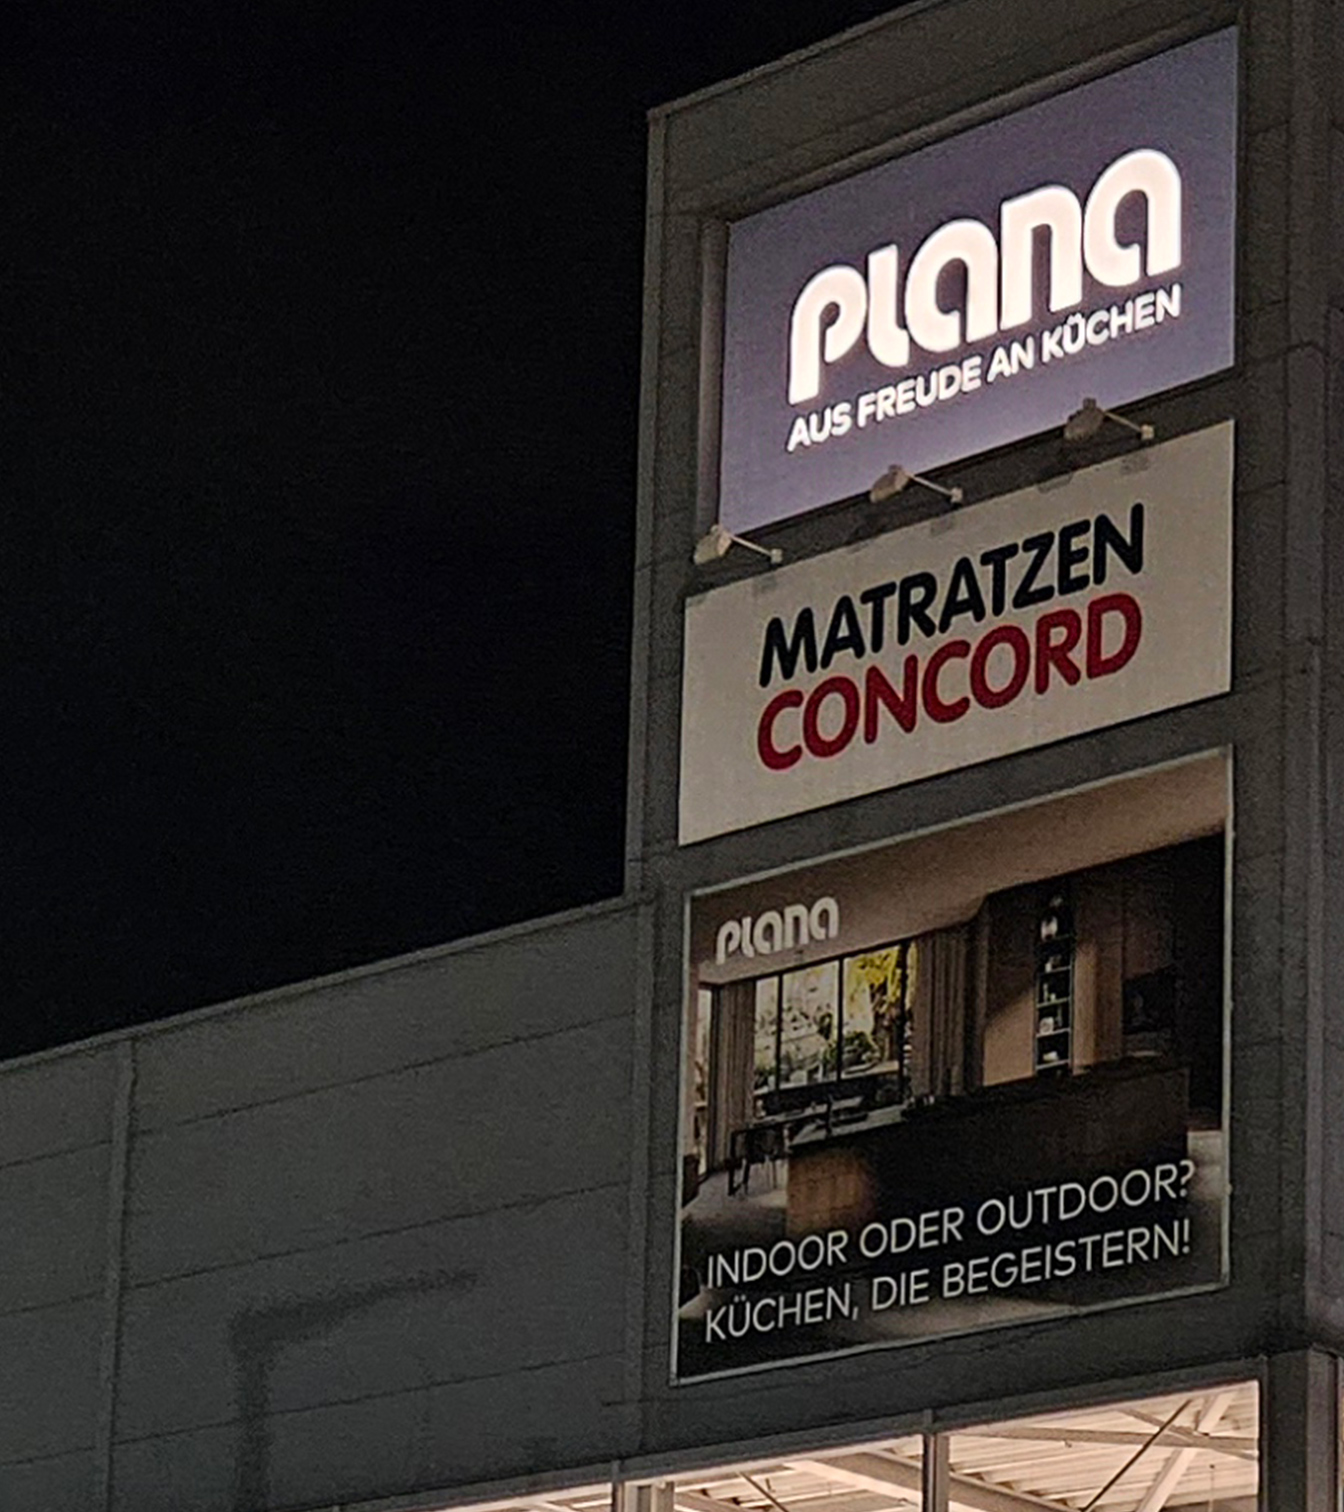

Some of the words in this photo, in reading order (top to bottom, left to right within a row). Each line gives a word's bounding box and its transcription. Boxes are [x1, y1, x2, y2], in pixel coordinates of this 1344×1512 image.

[786, 402, 853, 452] AUS
[856, 355, 983, 428] FREUDE
[987, 335, 1035, 383] AN
[1041, 283, 1183, 363] KÜCHEN
[758, 502, 1146, 689] MATRATZEN
[755, 591, 1143, 771] CONCORD
[705, 1282, 858, 1343] KÜCHEN,
[870, 1267, 930, 1311] DIE
[942, 1218, 1191, 1299] BEGEISTERN!
[706, 1230, 848, 1290] INDOOR
[858, 1207, 965, 1259] ODER
[976, 1159, 1195, 1236] OUTDOOR?
